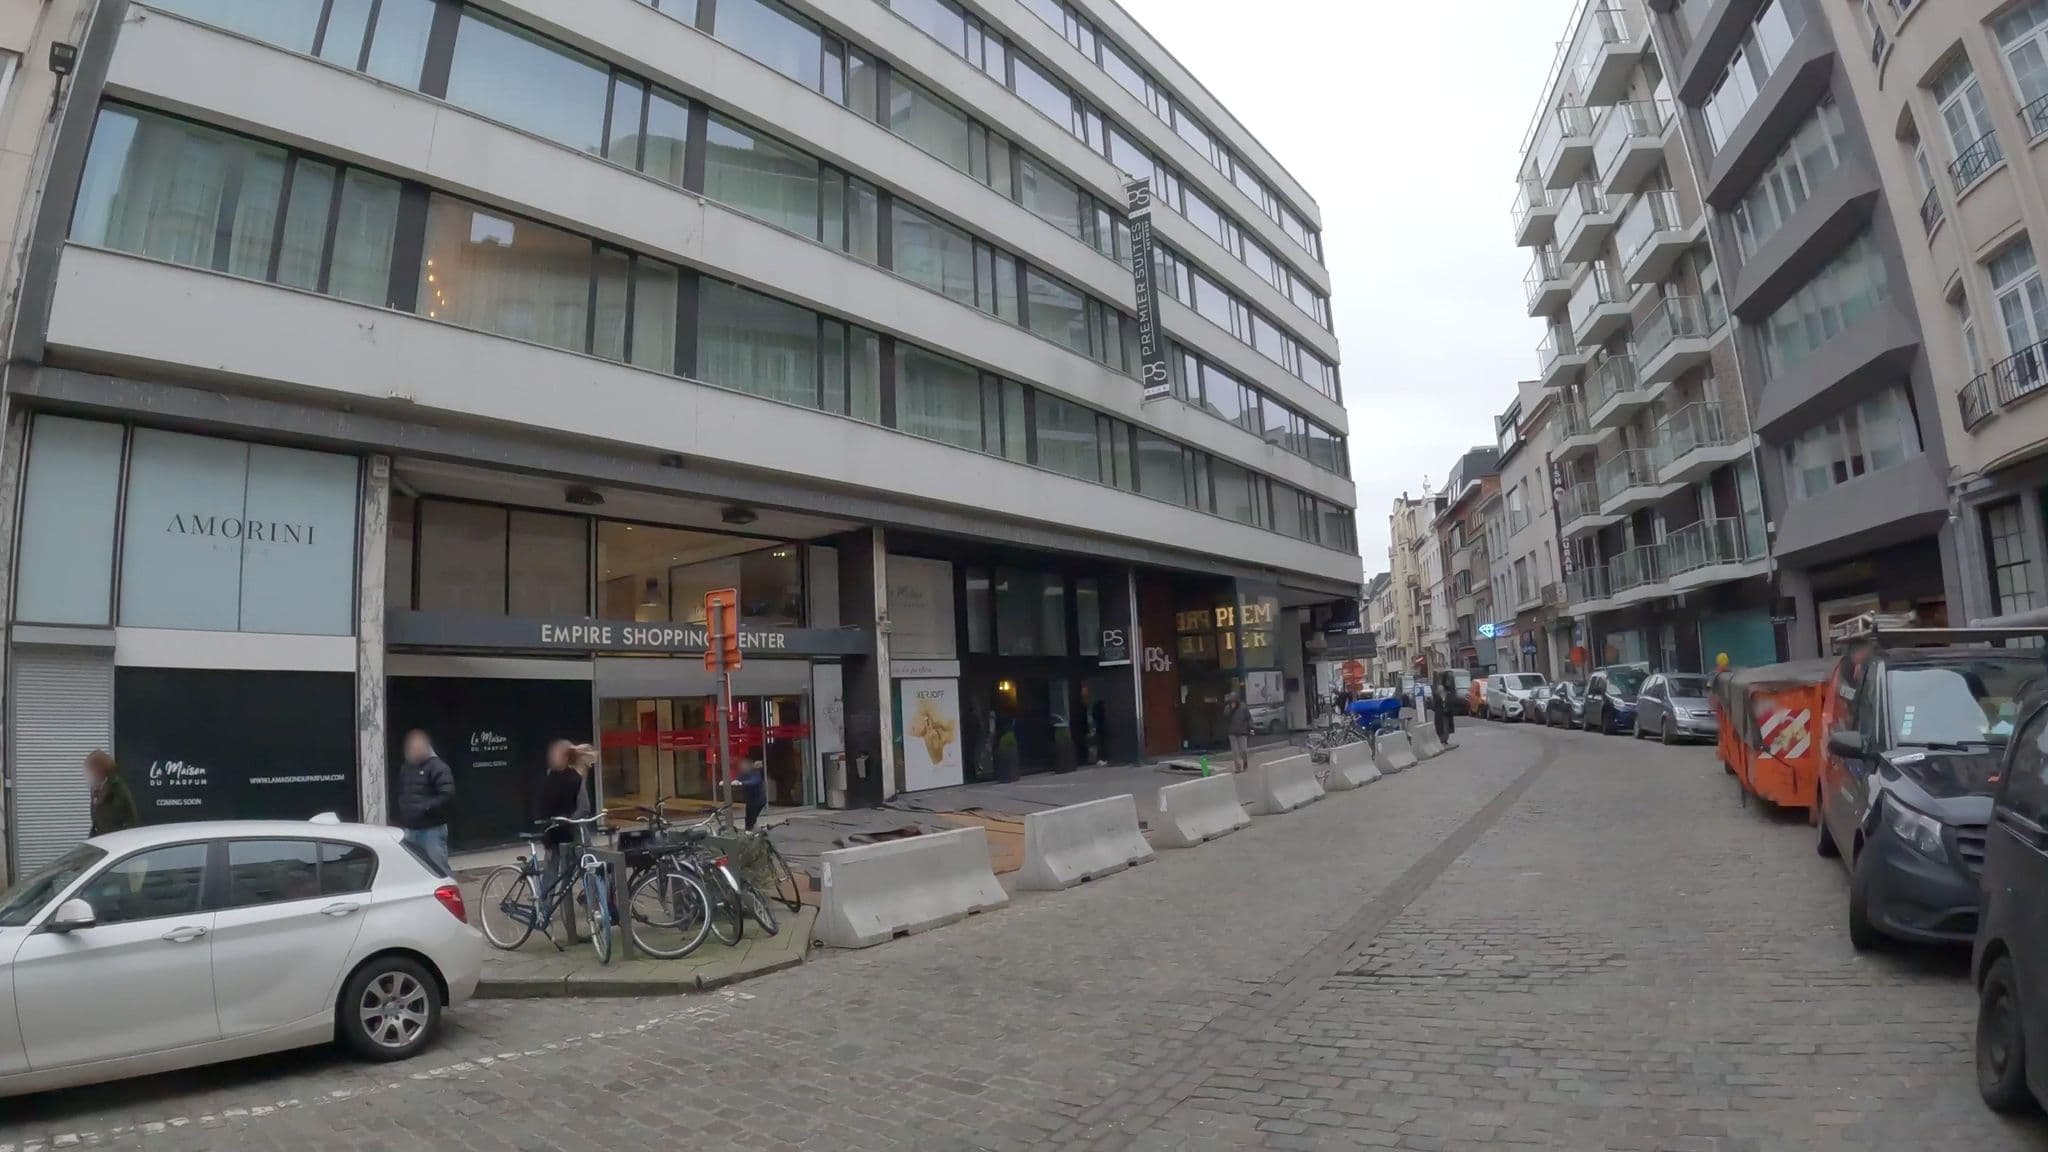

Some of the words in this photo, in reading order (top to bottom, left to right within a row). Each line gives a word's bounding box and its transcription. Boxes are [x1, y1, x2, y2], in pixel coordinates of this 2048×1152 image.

[1131, 222, 1146, 283] SUITES
[1136, 284, 1153, 356] PREMIER
[166, 513, 316, 545] AMORINI
[541, 624, 612, 645] EMPIRE
[738, 632, 786, 649] ENTER
[1103, 629, 1125, 647] PS
[150, 760, 162, 779] La
[164, 760, 207, 776] Maison
[169, 778, 208, 787] PARFUM
[156, 798, 183, 807] COMING
[183, 797, 203, 806] SOON
